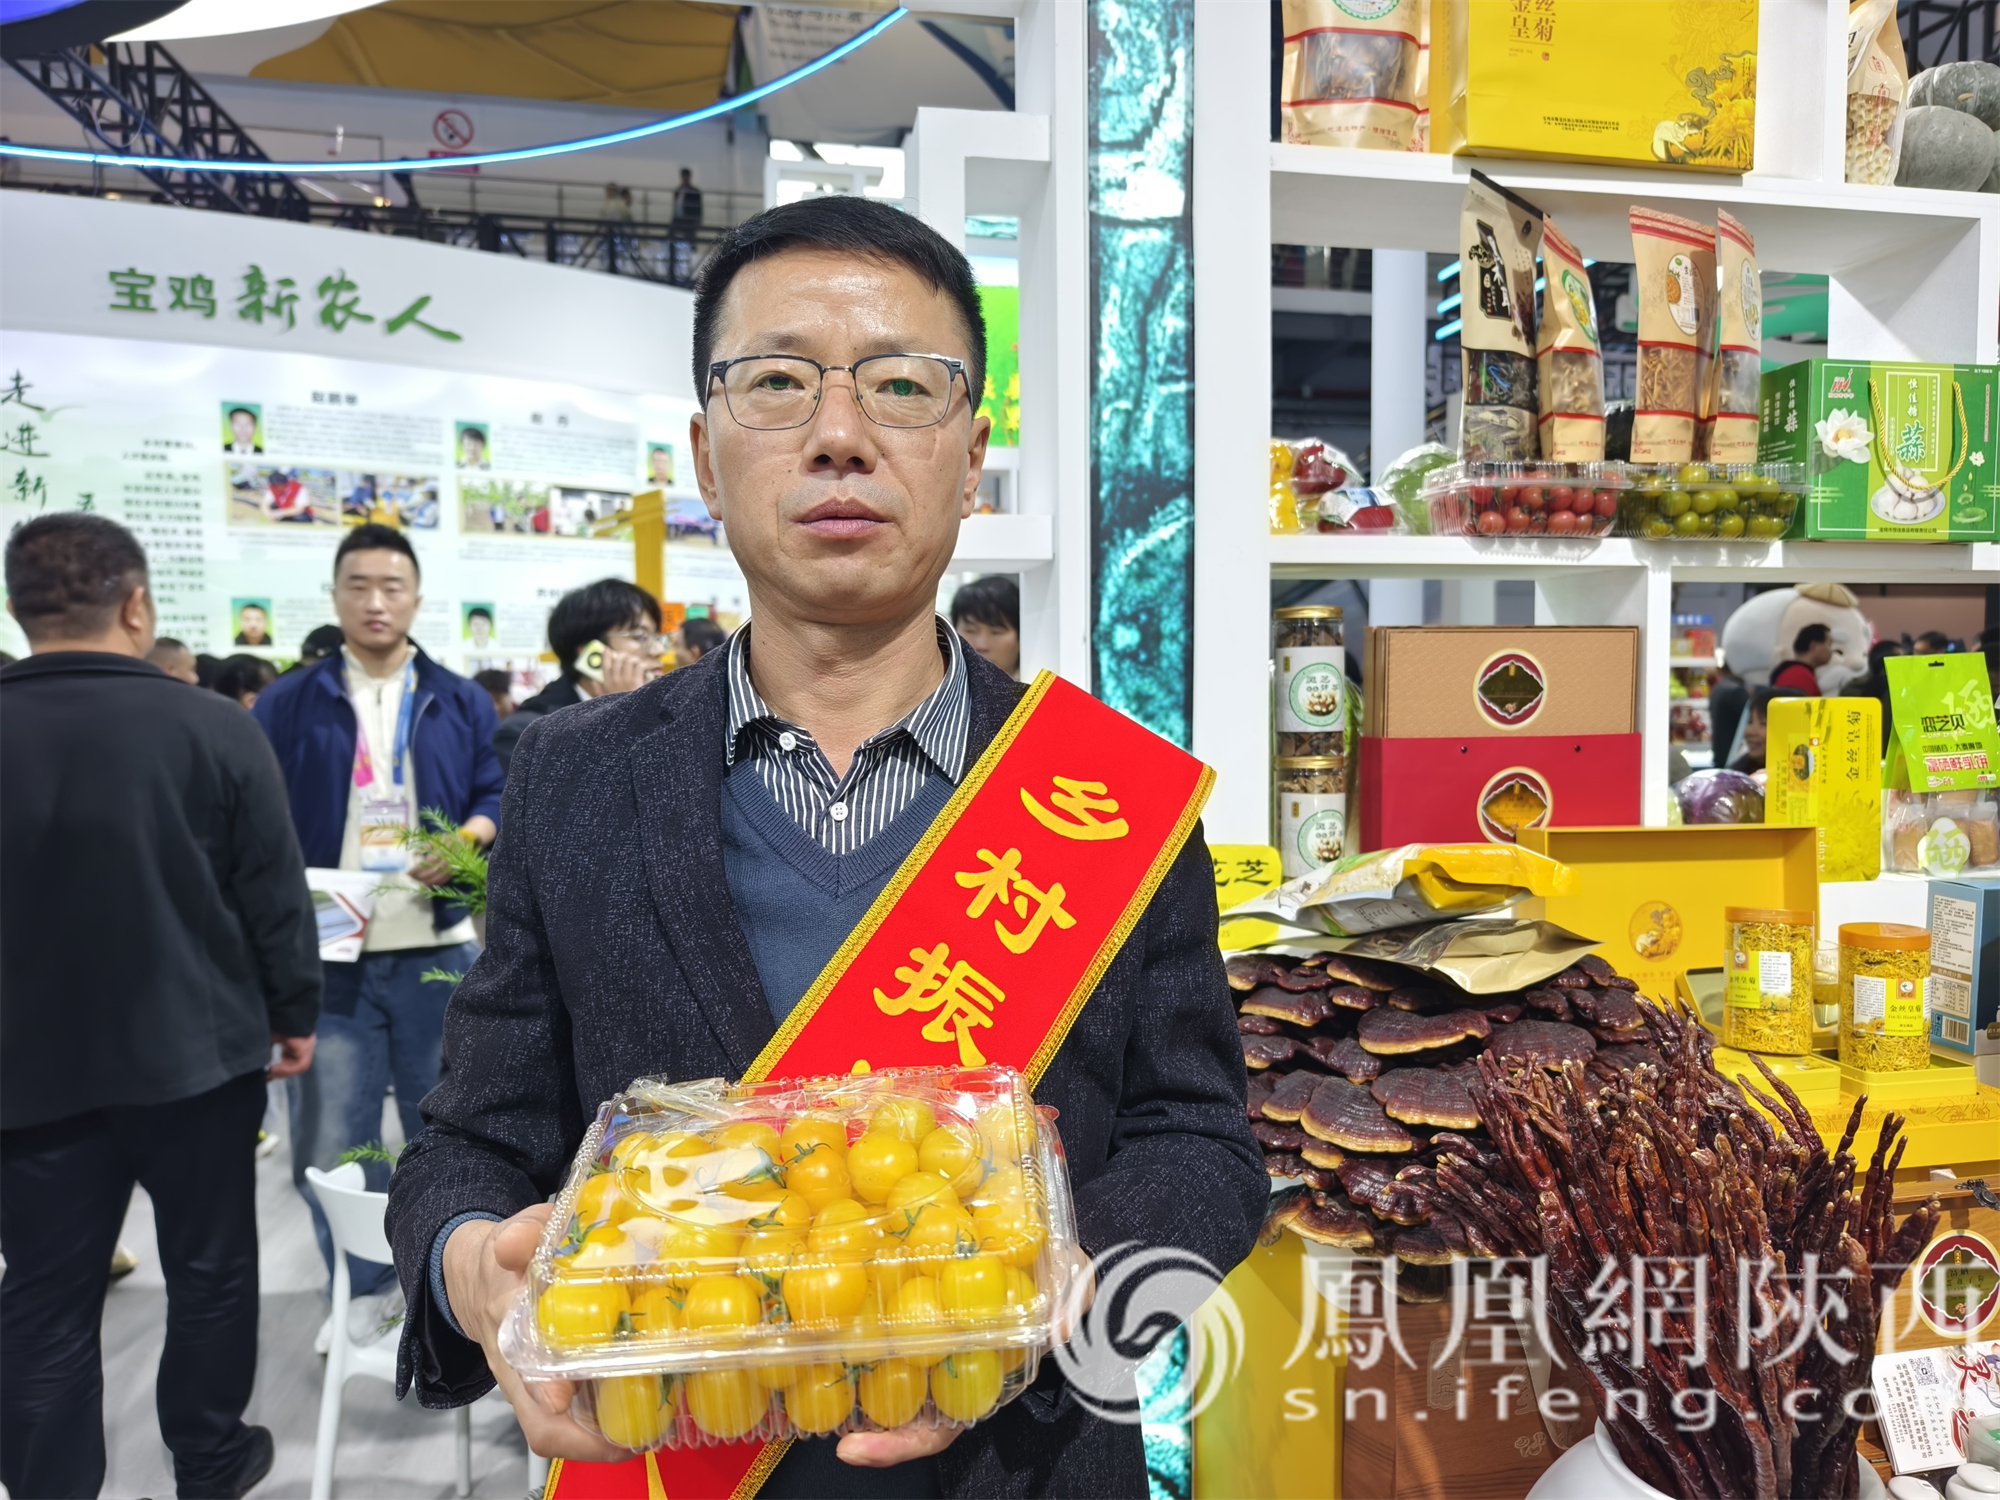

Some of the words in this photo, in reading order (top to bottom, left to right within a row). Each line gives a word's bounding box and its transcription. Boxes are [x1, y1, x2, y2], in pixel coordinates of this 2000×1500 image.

[1509, 14, 1556, 43] 皇菊
[106, 262, 464, 343] 宝鸡新农人
[0, 369, 51, 530] 走进新
[1846, 710, 1861, 781] 金丝皇菊
[1818, 840, 1828, 861] cup
[850, 775, 1130, 1076] 乡村振
